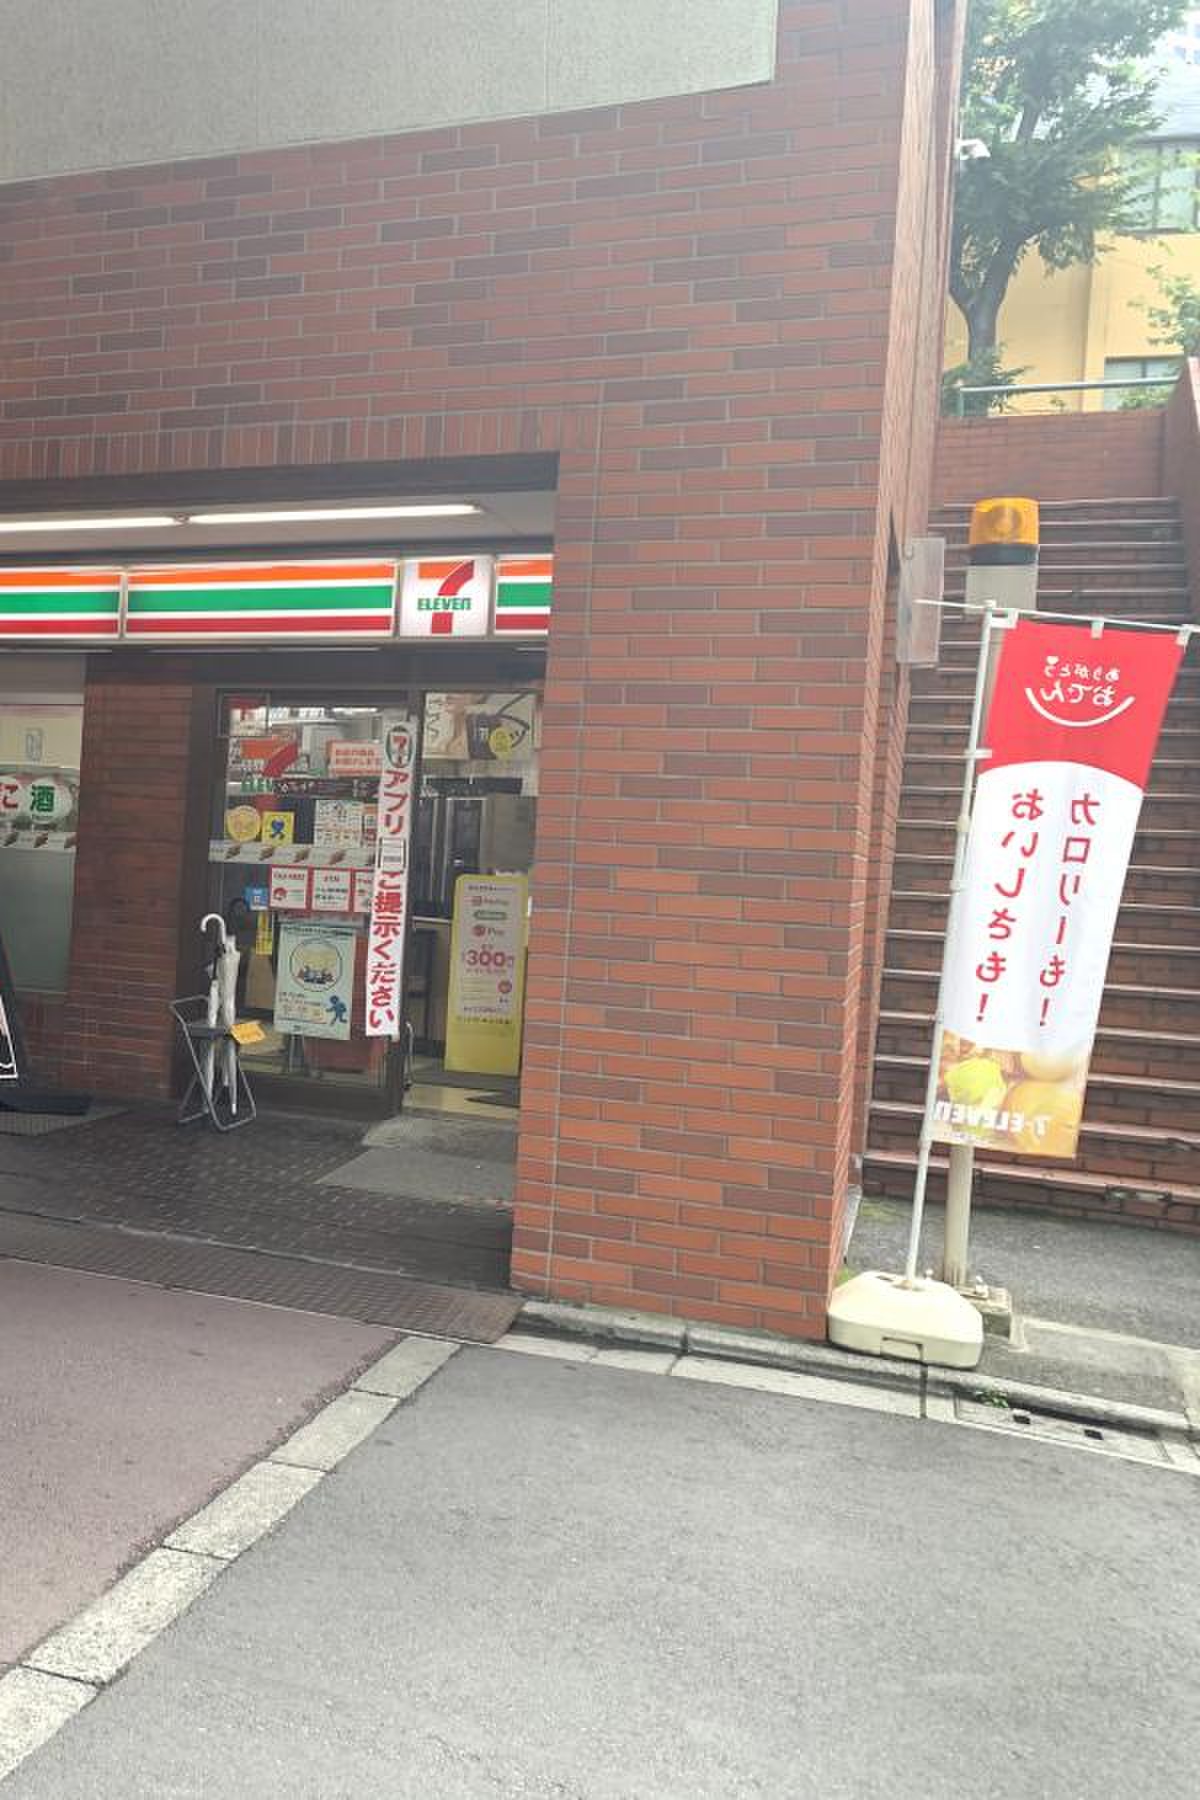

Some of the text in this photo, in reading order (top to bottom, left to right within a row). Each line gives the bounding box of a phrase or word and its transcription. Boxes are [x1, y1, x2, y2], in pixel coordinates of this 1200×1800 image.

[418, 560, 475, 634] 7
[30, 784, 56, 812] 酒
[383, 770, 409, 835] アプリ
[368, 870, 405, 1029] ご提示ください
